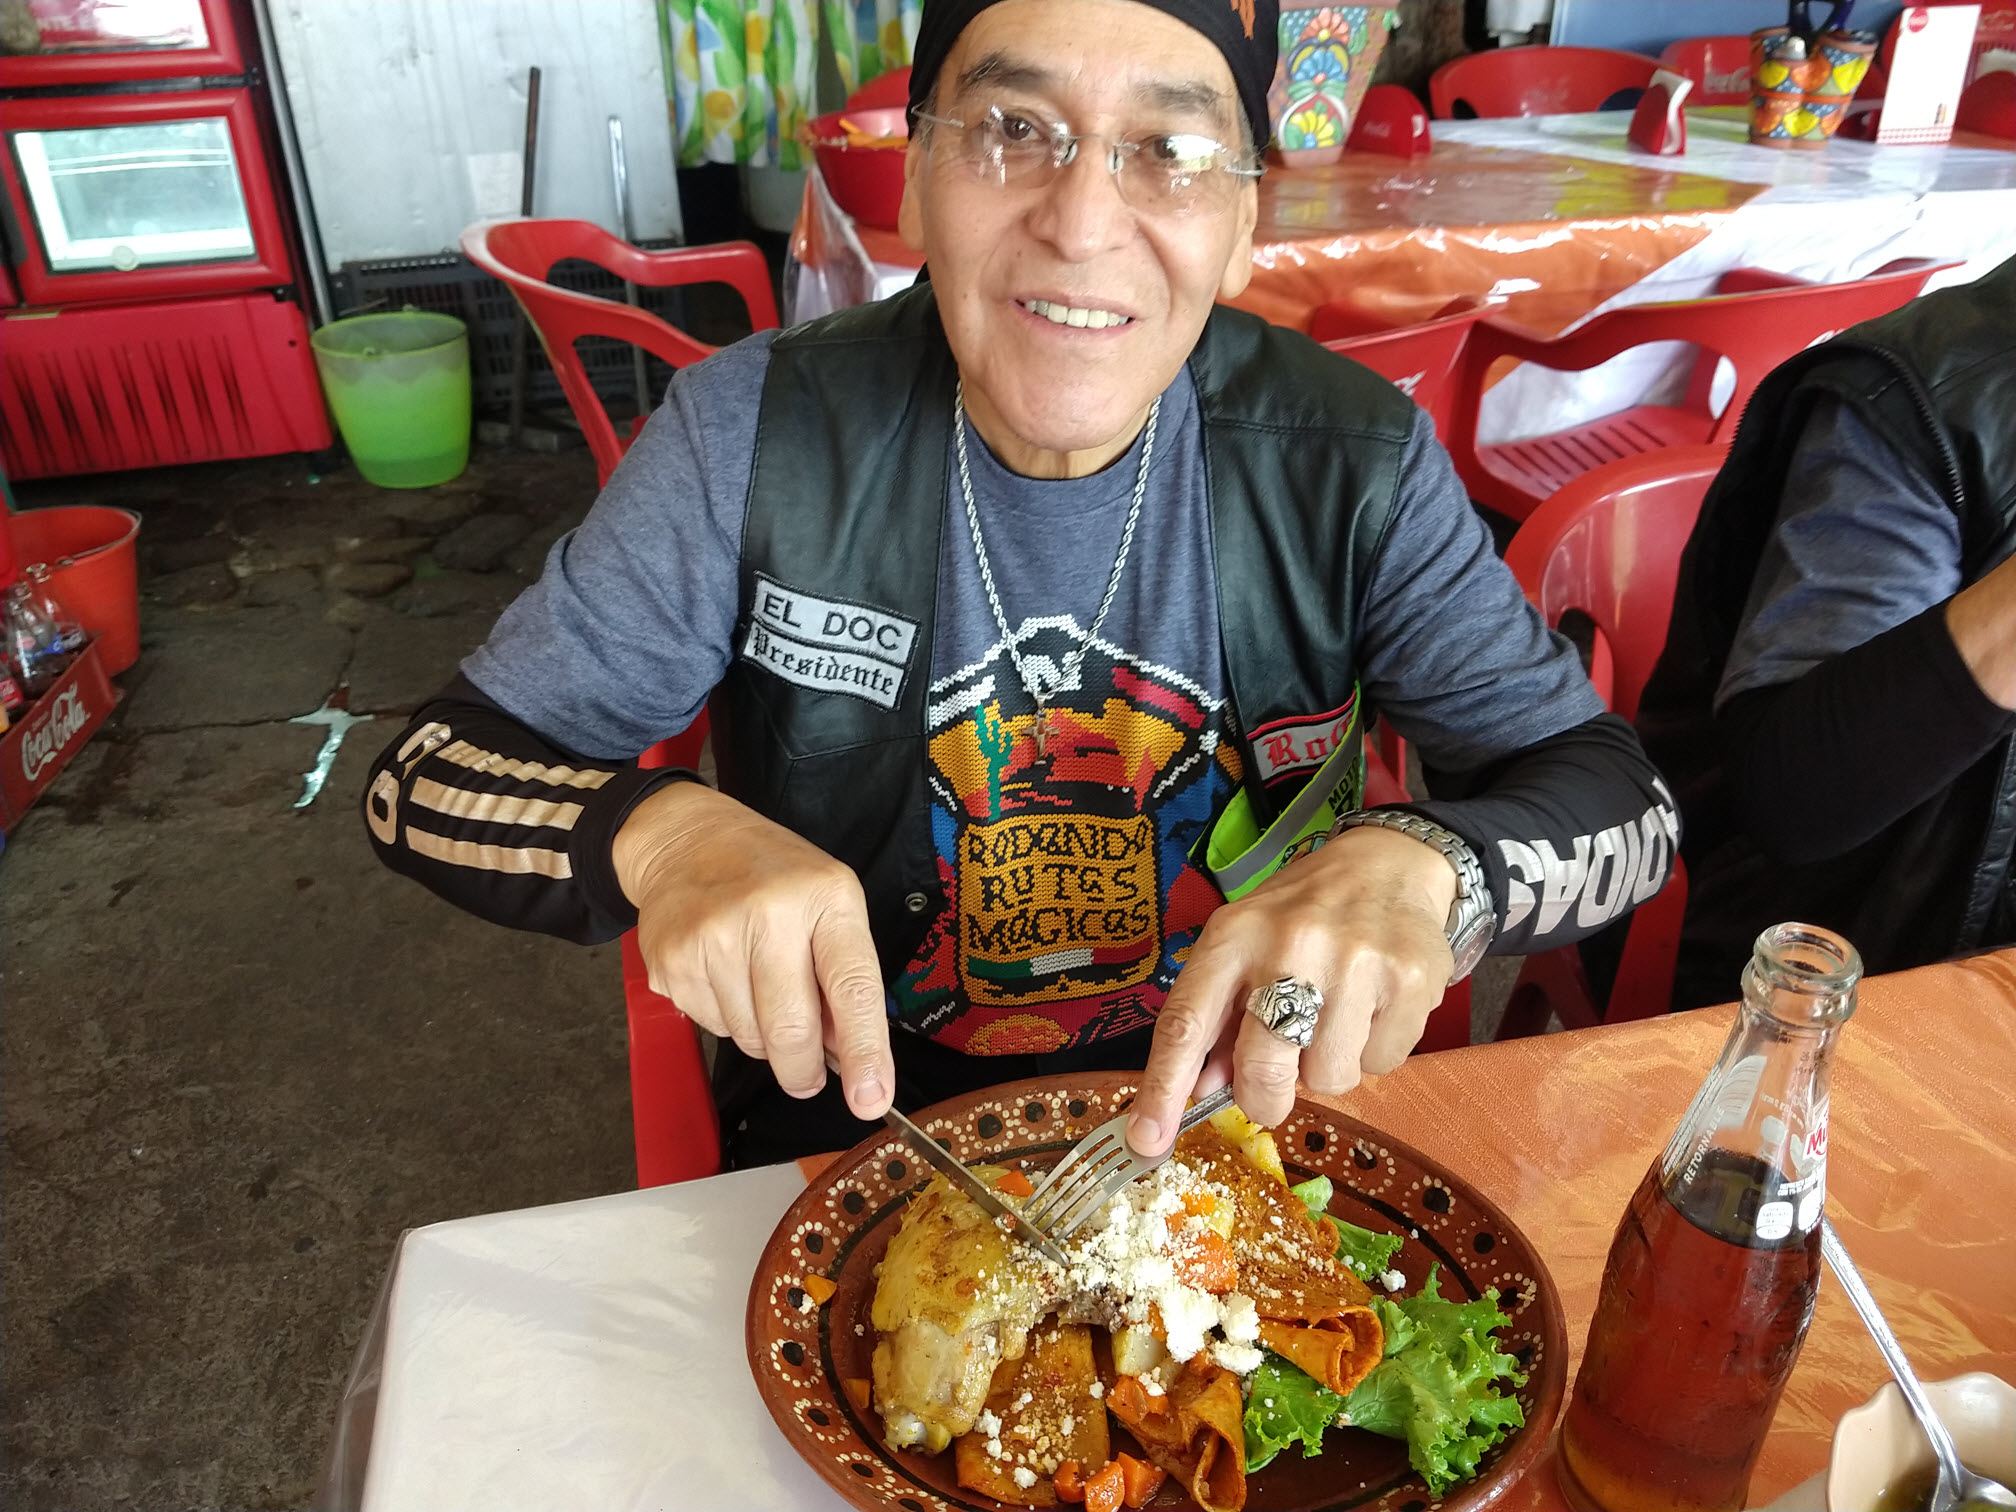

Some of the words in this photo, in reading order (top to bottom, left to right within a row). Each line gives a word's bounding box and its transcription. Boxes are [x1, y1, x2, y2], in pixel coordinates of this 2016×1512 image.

[763, 591, 801, 629] EL
[822, 611, 902, 651] DOC
[754, 626, 895, 696] Presidente
[1683, 1105, 1725, 1185] RETORNABLE
